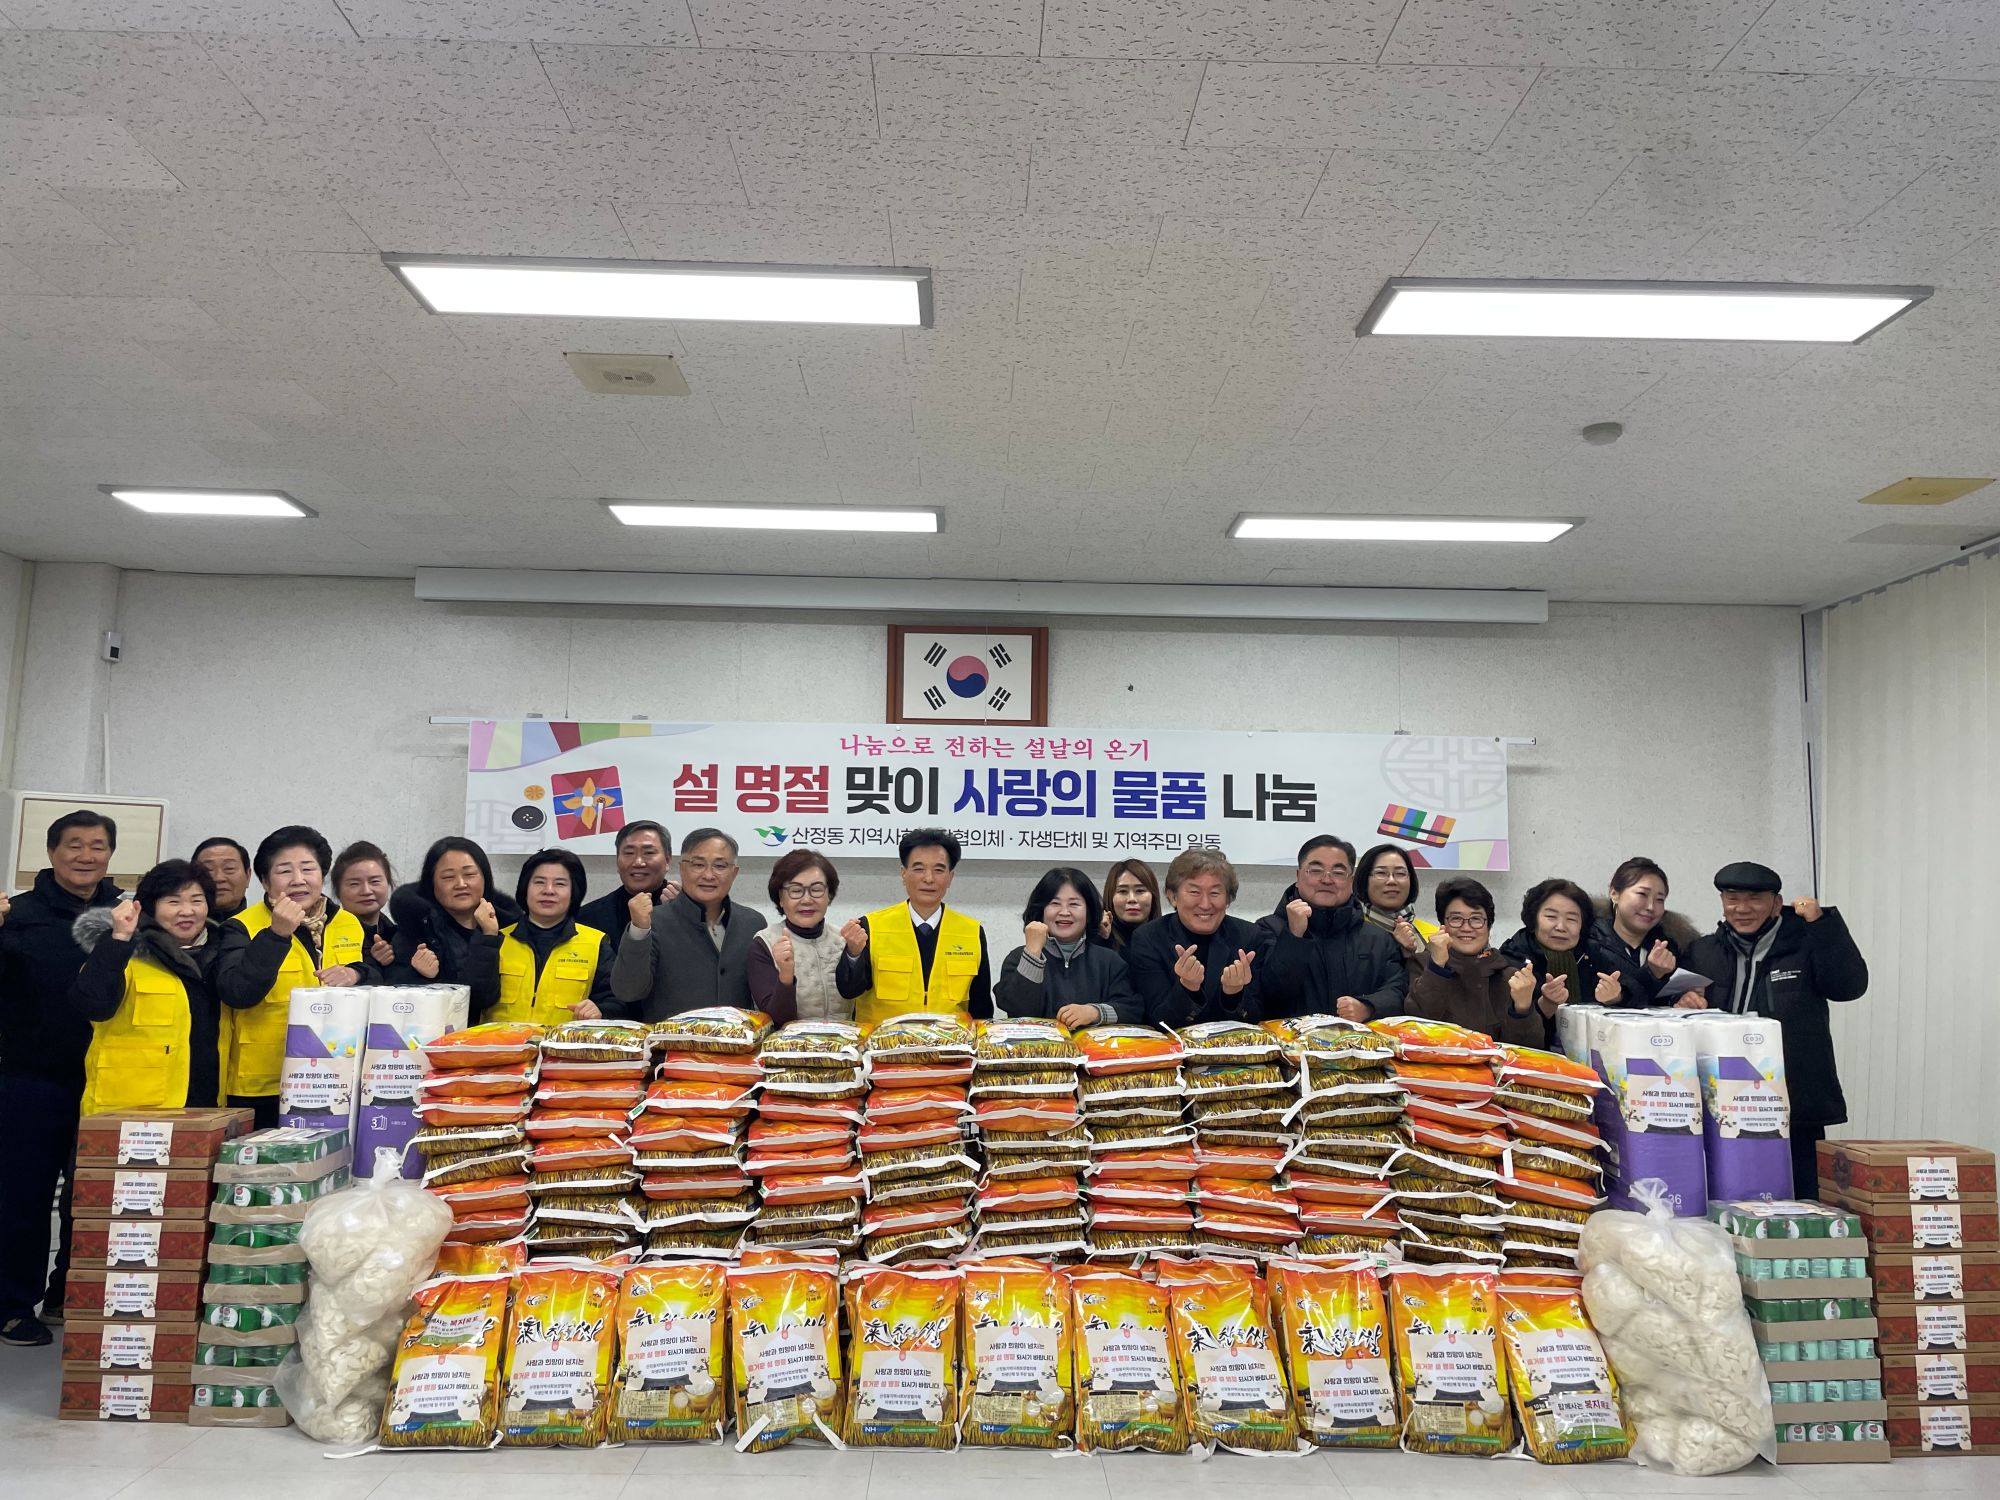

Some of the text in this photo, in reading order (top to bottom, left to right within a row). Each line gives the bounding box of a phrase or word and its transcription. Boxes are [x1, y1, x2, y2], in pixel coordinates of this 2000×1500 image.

[840, 734, 1149, 762] 나눔으로 전하는 설날의 온기
[673, 763, 1318, 822] 설 명절 맞이 사랑의 물품 나눔
[791, 827, 844, 846] 산정동
[1018, 830, 1087, 849] 자생단체
[1092, 832, 1108, 848] 및
[1114, 832, 1182, 850] 지역주민
[371, 1118, 378, 1128] 3
[759, 1349, 777, 1358] 사랑과
